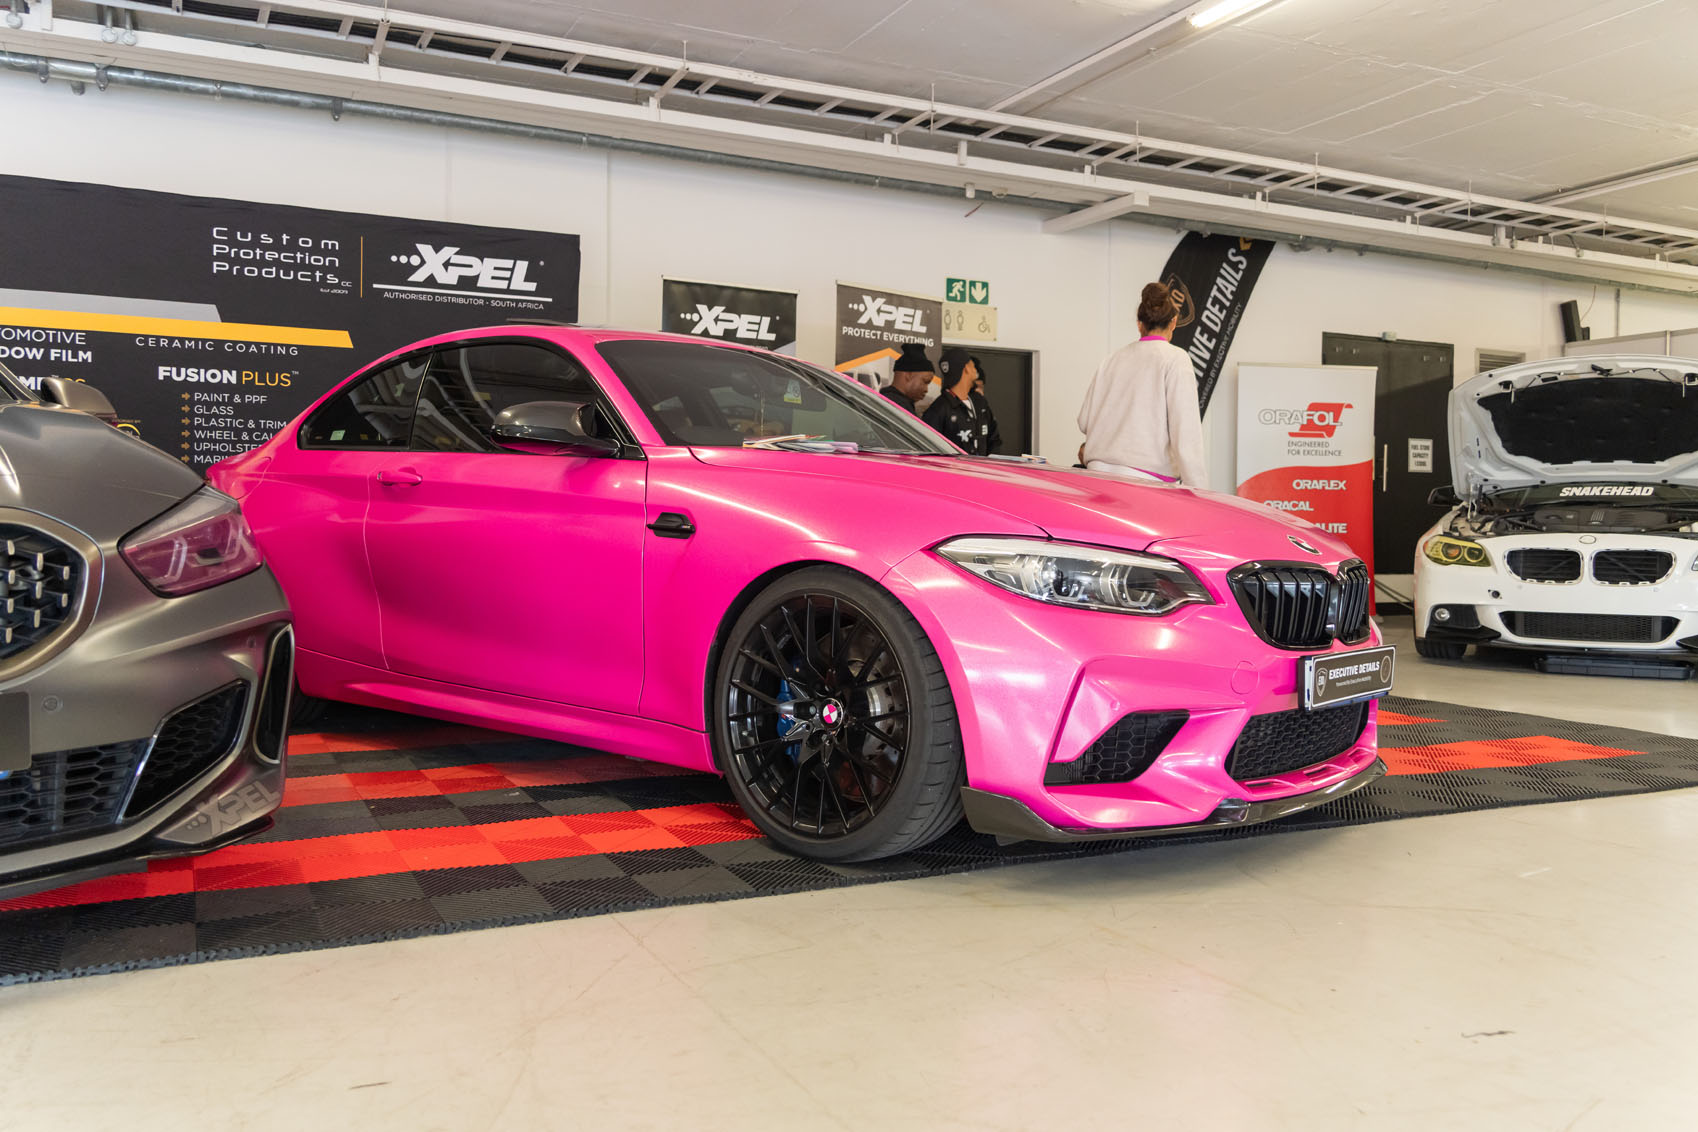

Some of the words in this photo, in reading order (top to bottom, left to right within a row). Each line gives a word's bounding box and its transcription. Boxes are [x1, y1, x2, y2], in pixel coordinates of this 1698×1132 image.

[213, 227, 339, 250] Custom
[213, 244, 339, 267] Protection
[213, 261, 339, 283] Products
[407, 243, 537, 291] XPEL
[383, 291, 434, 302] AUTHORISED
[435, 295, 484, 305] DISTRIBUTOR
[491, 299, 516, 308] SOUTH
[517, 301, 544, 310] AFRICA
[1201, 248, 1248, 334] DETAILS
[691, 304, 776, 340] XPEL
[857, 295, 928, 333] XPEL
[0, 327, 86, 345] OMOTIVE
[842, 326, 881, 340] PROTECT
[883, 332, 934, 347] EVERYTHING
[136, 336, 214, 350] CERAMIC
[224, 342, 299, 356] COATING
[50, 349, 92, 363] FILM
[158, 366, 237, 384] FUSION
[194, 392, 230, 402] PAINT
[233, 394, 241, 403] &
[245, 394, 268, 404] PPF
[194, 405, 234, 415] GLASS
[1259, 409, 1343, 427] ORAFOL
[194, 417, 244, 428] PLASTIC
[247, 419, 255, 428] &
[259, 420, 287, 429] TRIM
[194, 430, 238, 440] WHEEL
[241, 432, 249, 441] &
[1288, 440, 1329, 448] ENGINEERED
[1292, 479, 1347, 491] ORAFLEX
[1560, 486, 1655, 497] SNAKEHEAD
[1329, 665, 1359, 680] EXECUTIVE
[1358, 661, 1380, 674] DETAILS
[197, 780, 281, 836] XPEL
